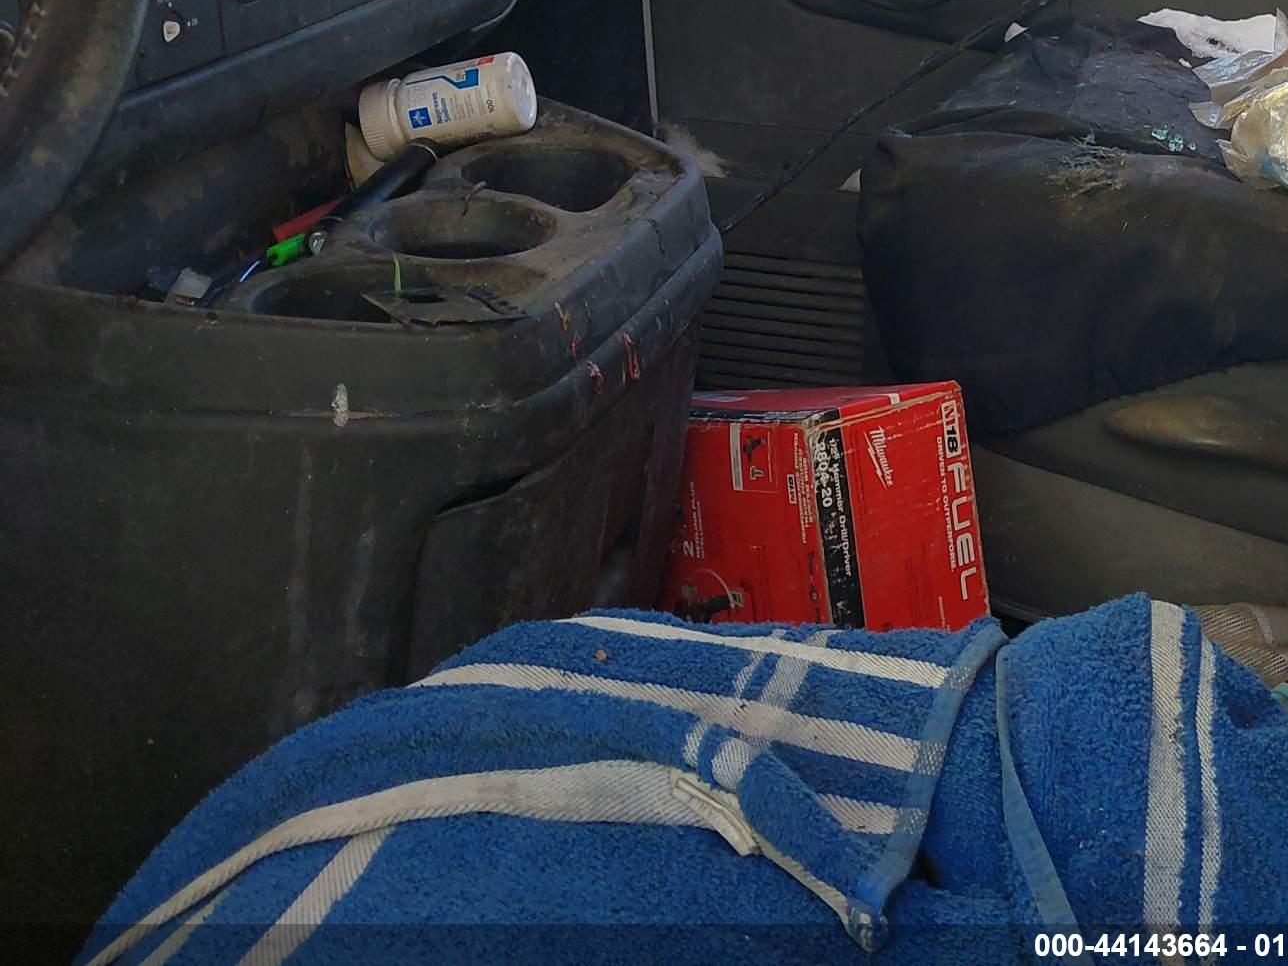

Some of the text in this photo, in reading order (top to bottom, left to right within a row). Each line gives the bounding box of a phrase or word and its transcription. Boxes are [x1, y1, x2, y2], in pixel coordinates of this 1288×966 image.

[868, 425, 894, 488] Milwaukee
[936, 436, 946, 477] DRIVEN
[832, 462, 845, 513] Hammer
[940, 478, 949, 494] TO
[838, 514, 853, 577] Drill/Driver
[946, 461, 977, 602] FUEL
